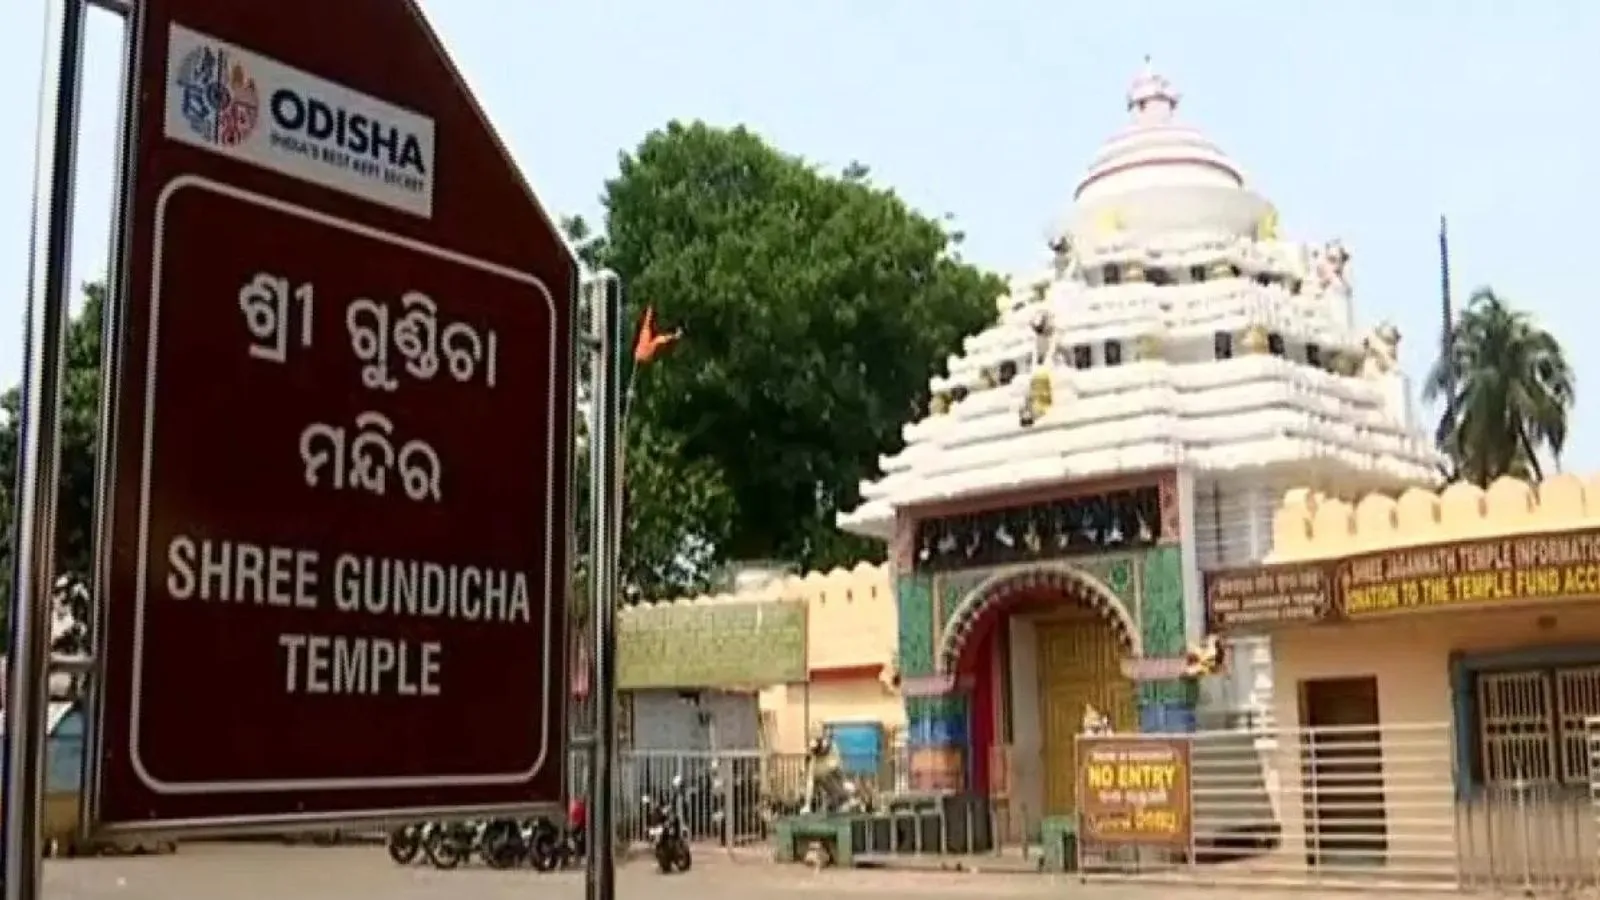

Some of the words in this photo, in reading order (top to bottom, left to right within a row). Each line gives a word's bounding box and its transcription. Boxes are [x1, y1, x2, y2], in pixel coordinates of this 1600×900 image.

[270, 88, 425, 174] ODISHA
[239, 272, 313, 363] ଶ୍ରୀ
[346, 290, 496, 392] ଗୁଣ୍ଡିଚା
[299, 410, 441, 502] ମନ୍ଦିର
[167, 535, 319, 608] SHREE
[334, 553, 530, 624] GUNDICHA
[1401, 579, 1419, 607] TO
[1421, 576, 1448, 605] THE
[1453, 569, 1512, 601] TEMPLE
[1515, 566, 1559, 598] FUND
[1459, 540, 1512, 572] TEMPLE
[279, 632, 441, 696] TEMPLE
[1088, 763, 1115, 789] NO
[1118, 763, 1176, 790] ENTRY
